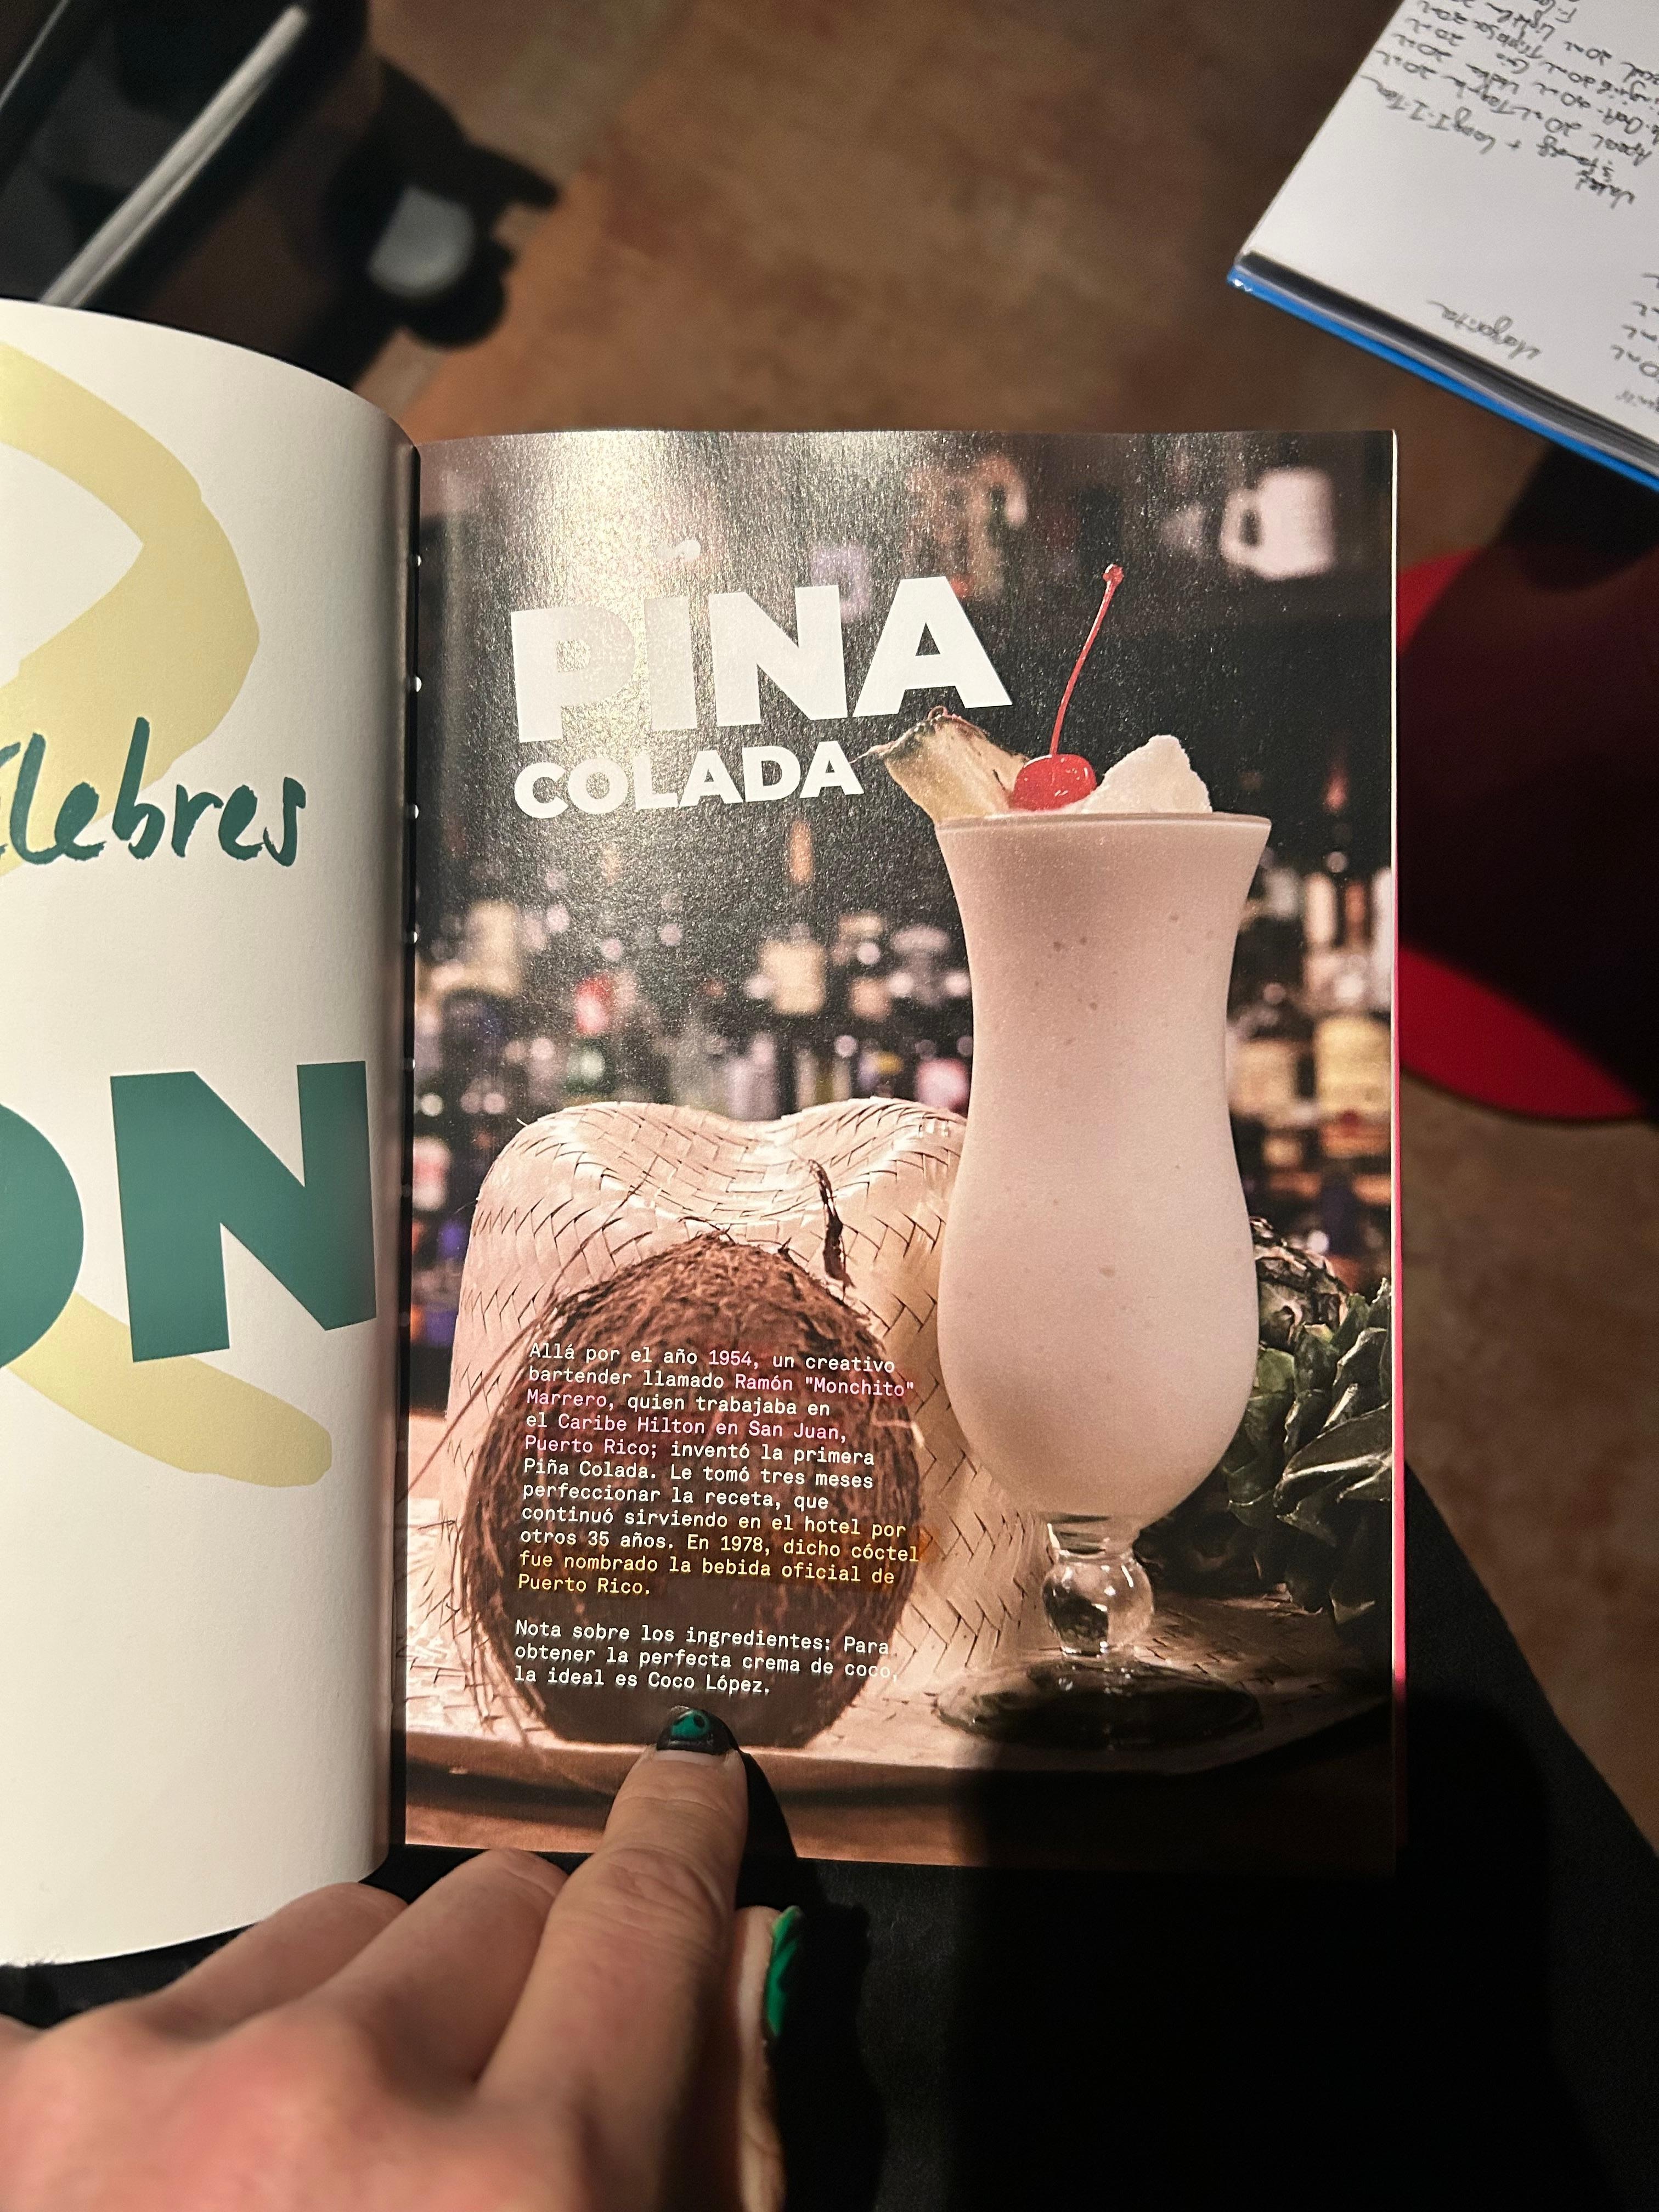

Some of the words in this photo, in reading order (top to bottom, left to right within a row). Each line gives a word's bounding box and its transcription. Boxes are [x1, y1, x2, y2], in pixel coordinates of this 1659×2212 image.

[514, 741, 864, 819] COLADA
[529, 1342, 575, 1361] Allá
[586, 1347, 620, 1366] por
[631, 1347, 653, 1364] el
[663, 1348, 697, 1364] año
[708, 1350, 758, 1370] 1954,
[772, 1356, 794, 1368] un
[805, 1356, 895, 1373] creativo
[529, 1366, 632, 1386] bartender
[643, 1369, 724, 1389] llamado
[735, 1373, 793, 1391] Ramón
[805, 1376, 914, 1401] "Monchito"
[527, 1388, 614, 1411] Marrero,
[628, 1393, 685, 1413] quien
[696, 1396, 797, 1417] trabajaba
[808, 1403, 830, 1416] en
[526, 1412, 548, 1427] el
[558, 1412, 627, 1431] Caribe
[637, 1416, 704, 1434] Hilton
[716, 1423, 738, 1435] en
[748, 1420, 783, 1437] San
[793, 1422, 846, 1443] Juan,
[525, 1435, 593, 1454] Puerto
[604, 1438, 656, 1459] Rico;
[670, 1440, 750, 1459] inventó
[761, 1443, 783, 1460] la
[794, 1446, 874, 1465] primera
[523, 1457, 569, 1476] Piña
[579, 1460, 656, 1479] Colada.
[670, 1464, 692, 1480] Le
[703, 1465, 750, 1482] tomó
[760, 1468, 805, 1486] tres
[815, 1473, 873, 1489] meses
[523, 1482, 661, 1504] perfeccionar
[672, 1486, 693, 1503] la
[706, 1491, 781, 1510] receta,
[794, 1496, 828, 1512] que
[522, 1505, 613, 1524] continuó
[624, 1508, 727, 1528] sirviendo
[738, 1516, 760, 1529] en
[771, 1514, 793, 1531] el
[805, 1515, 861, 1535] hotel
[872, 1523, 906, 1540] por
[520, 1528, 577, 1545] otros
[588, 1530, 610, 1547] 35
[620, 1532, 673, 1549] años.
[687, 1533, 709, 1550] En
[720, 1536, 770, 1556] 1978,
[783, 1538, 840, 1556] dicho
[851, 1543, 919, 1562] cóctel
[520, 1550, 553, 1567] fue
[564, 1554, 658, 1571] nombrado
[669, 1556, 691, 1572] la
[702, 1557, 771, 1576] bebida
[782, 1561, 861, 1582] oficial
[872, 1567, 894, 1584] de
[518, 1573, 586, 1592] Puerto
[597, 1577, 650, 1594] Rico.
[516, 1619, 561, 1638] Nota
[573, 1623, 630, 1641] sobre
[641, 1624, 674, 1642] los
[686, 1626, 830, 1651] ingredientes:
[844, 1635, 889, 1655] Para
[515, 1643, 596, 1663] obtener
[606, 1646, 629, 1663] la
[639, 1649, 731, 1669] perfecta
[742, 1656, 800, 1673] crema
[811, 1657, 834, 1674] de
[844, 1663, 897, 1680] coco,
[515, 1665, 537, 1682] la
[548, 1667, 605, 1685] ideal
[616, 1674, 637, 1686] es
[648, 1671, 695, 1689] Coco
[706, 1673, 769, 1697] López.
